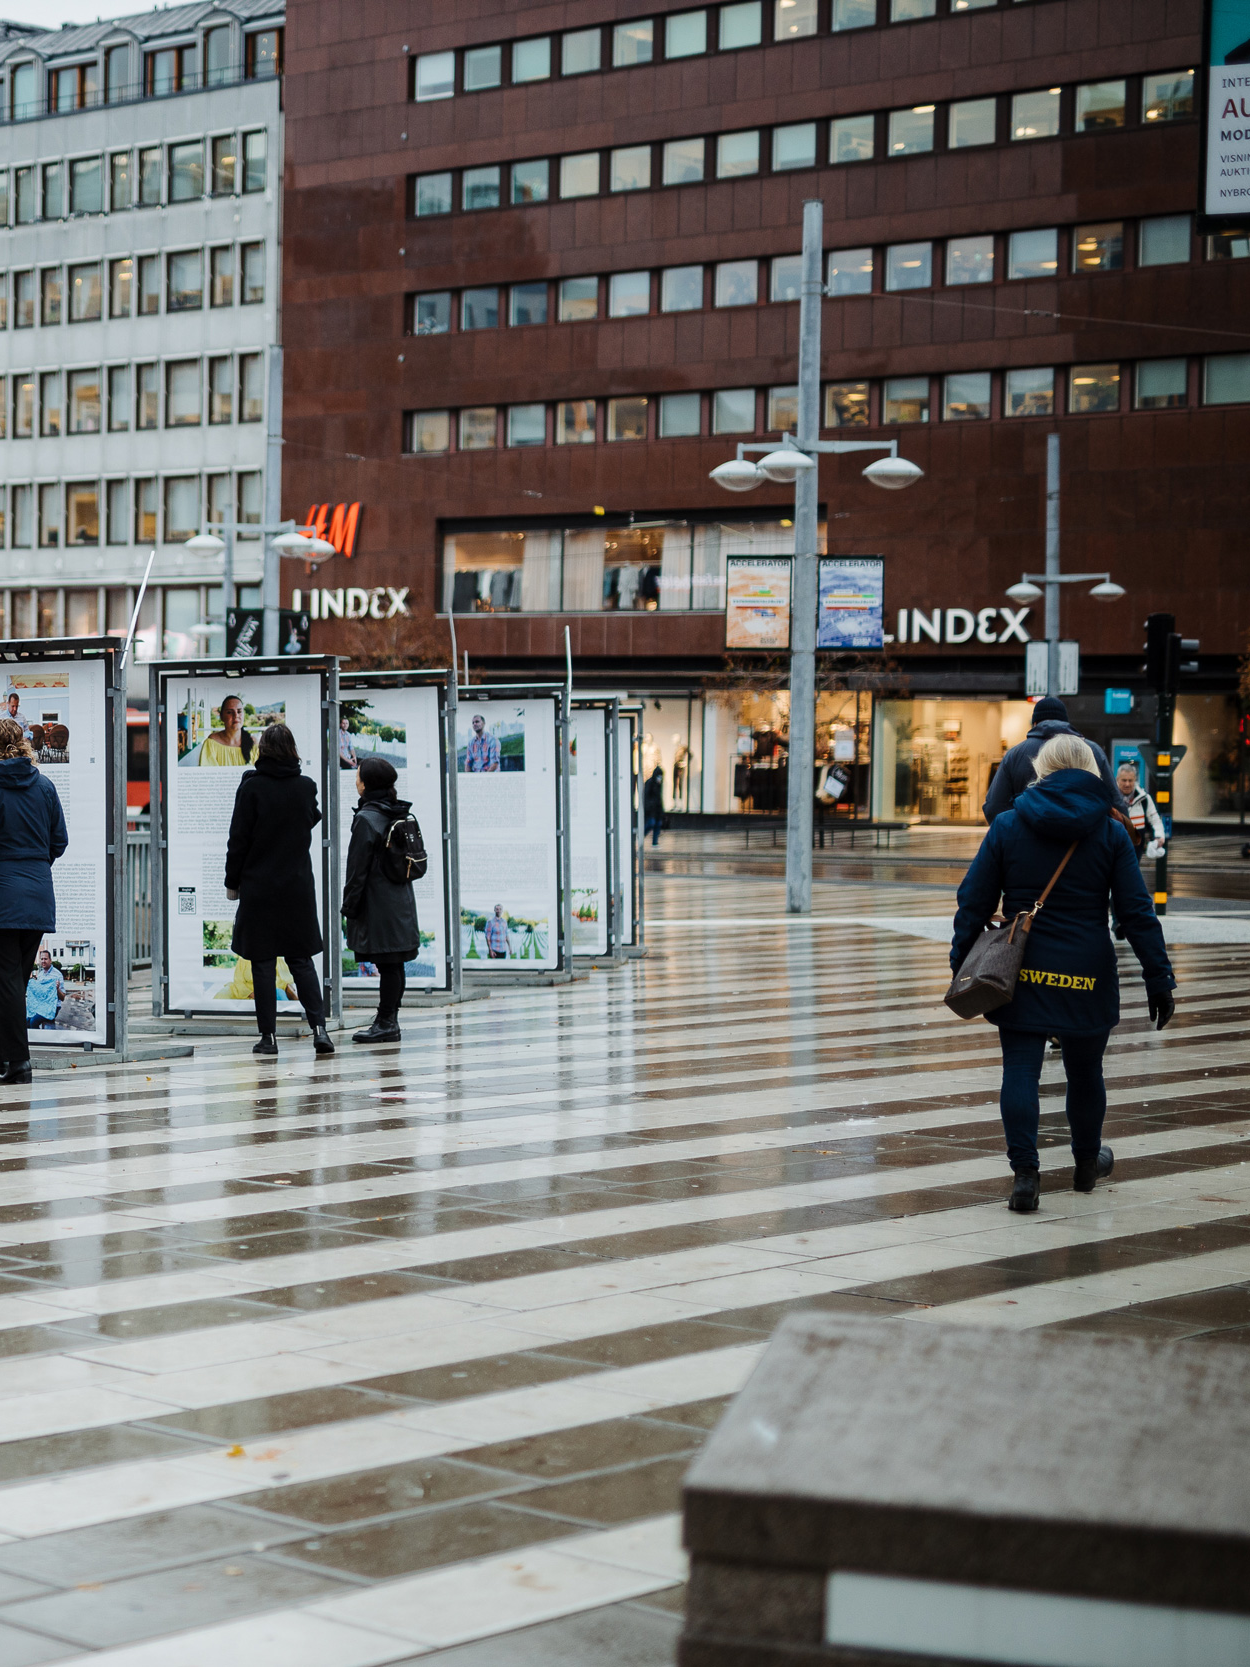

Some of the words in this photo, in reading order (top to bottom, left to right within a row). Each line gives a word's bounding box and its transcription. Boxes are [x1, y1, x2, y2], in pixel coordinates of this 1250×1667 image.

[292, 586, 410, 620] LINDEX
[883, 607, 1030, 643] INDEX
[1019, 969, 1096, 990] SWEDEN
